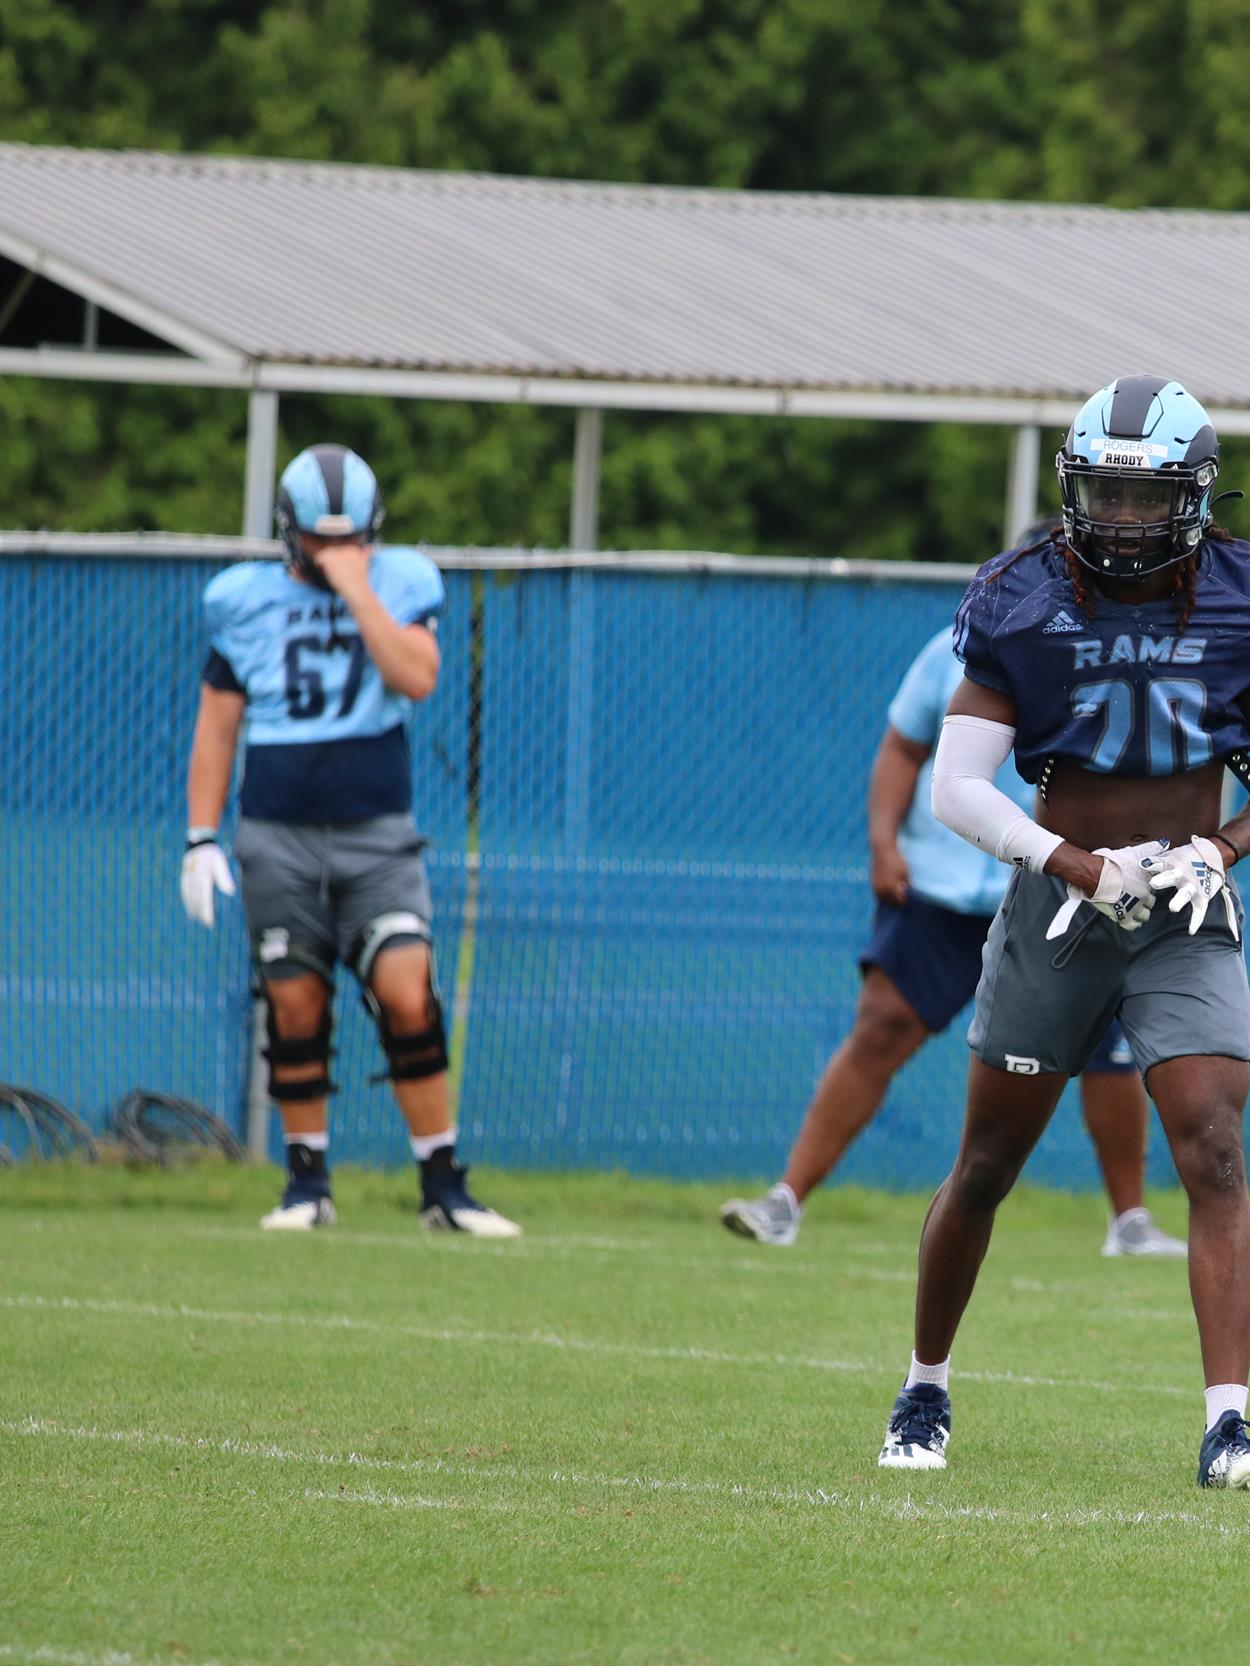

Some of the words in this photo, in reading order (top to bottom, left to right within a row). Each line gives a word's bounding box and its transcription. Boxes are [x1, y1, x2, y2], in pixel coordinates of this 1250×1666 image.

[1103, 440, 1153, 454] ROGERS
[1105, 453, 1144, 466] RHODY
[1042, 623, 1084, 634] adidas
[1071, 634, 1207, 670] RAMS
[284, 633, 365, 720] 67
